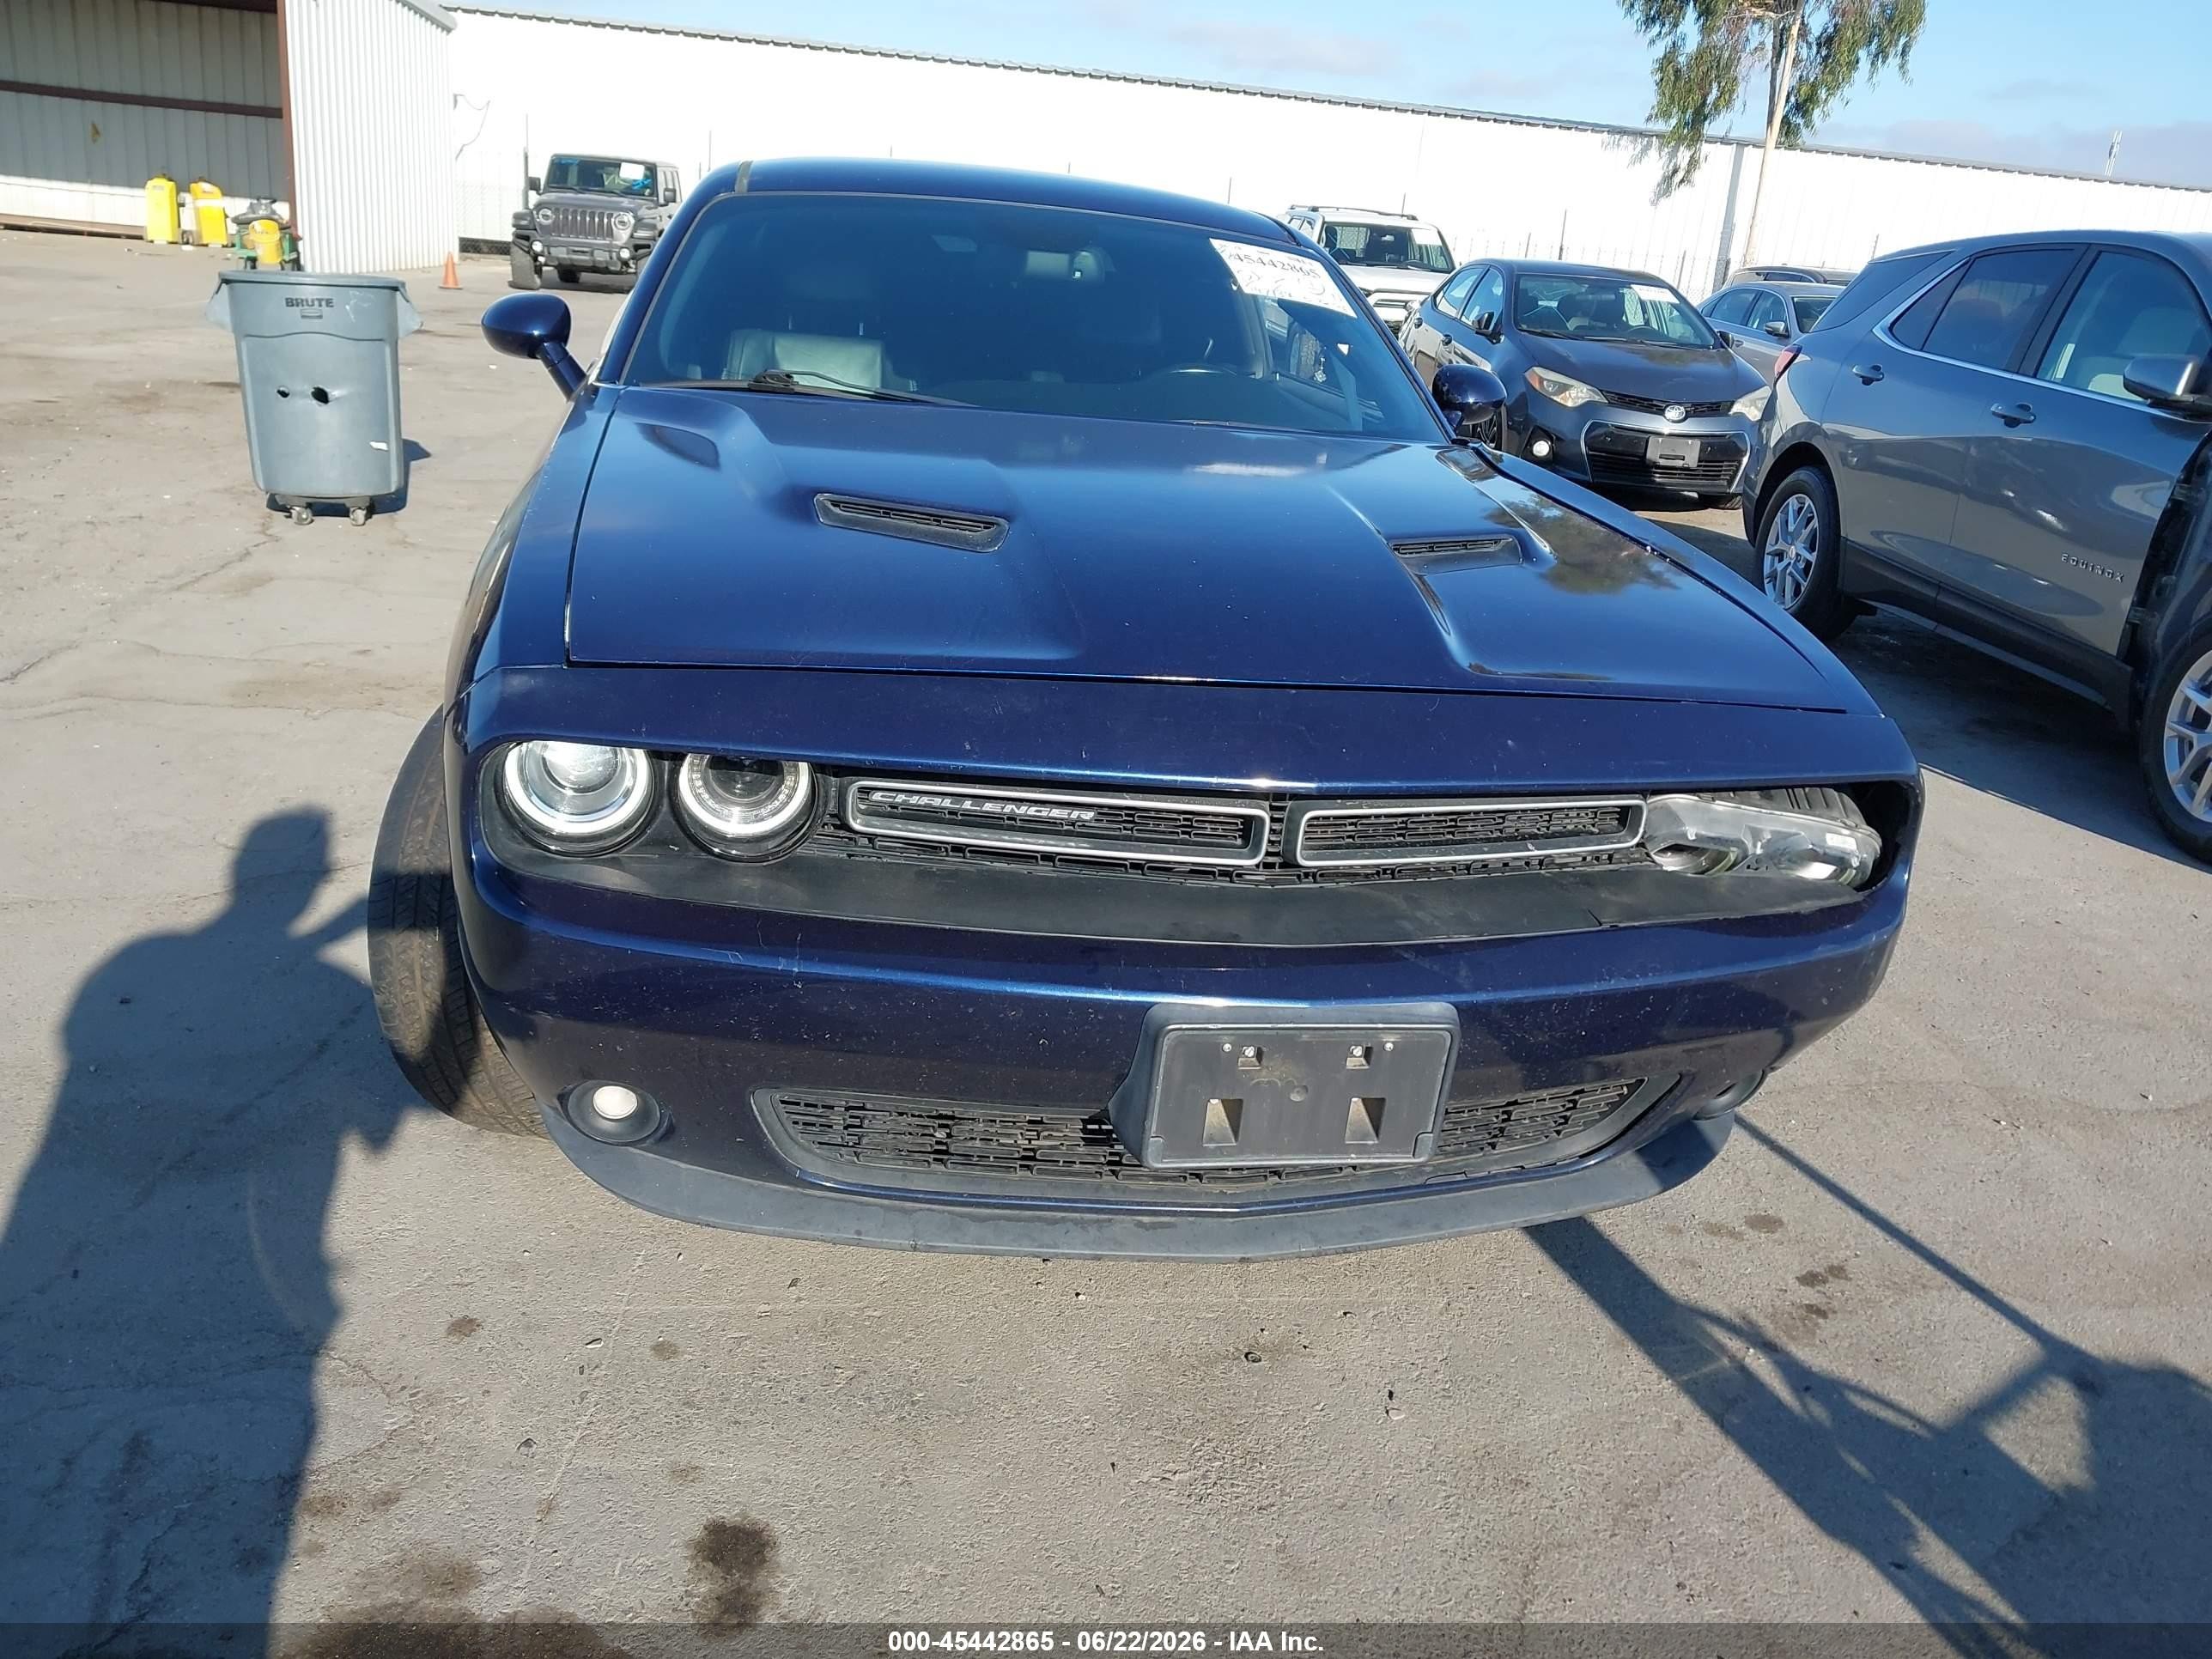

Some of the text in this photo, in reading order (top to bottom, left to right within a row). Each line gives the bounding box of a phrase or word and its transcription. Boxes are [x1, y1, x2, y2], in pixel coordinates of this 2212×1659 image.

[285, 297, 335, 308] BRUTE
[2061, 553, 2125, 583] EQUINOX
[872, 792, 1095, 820] CHALLENGER
